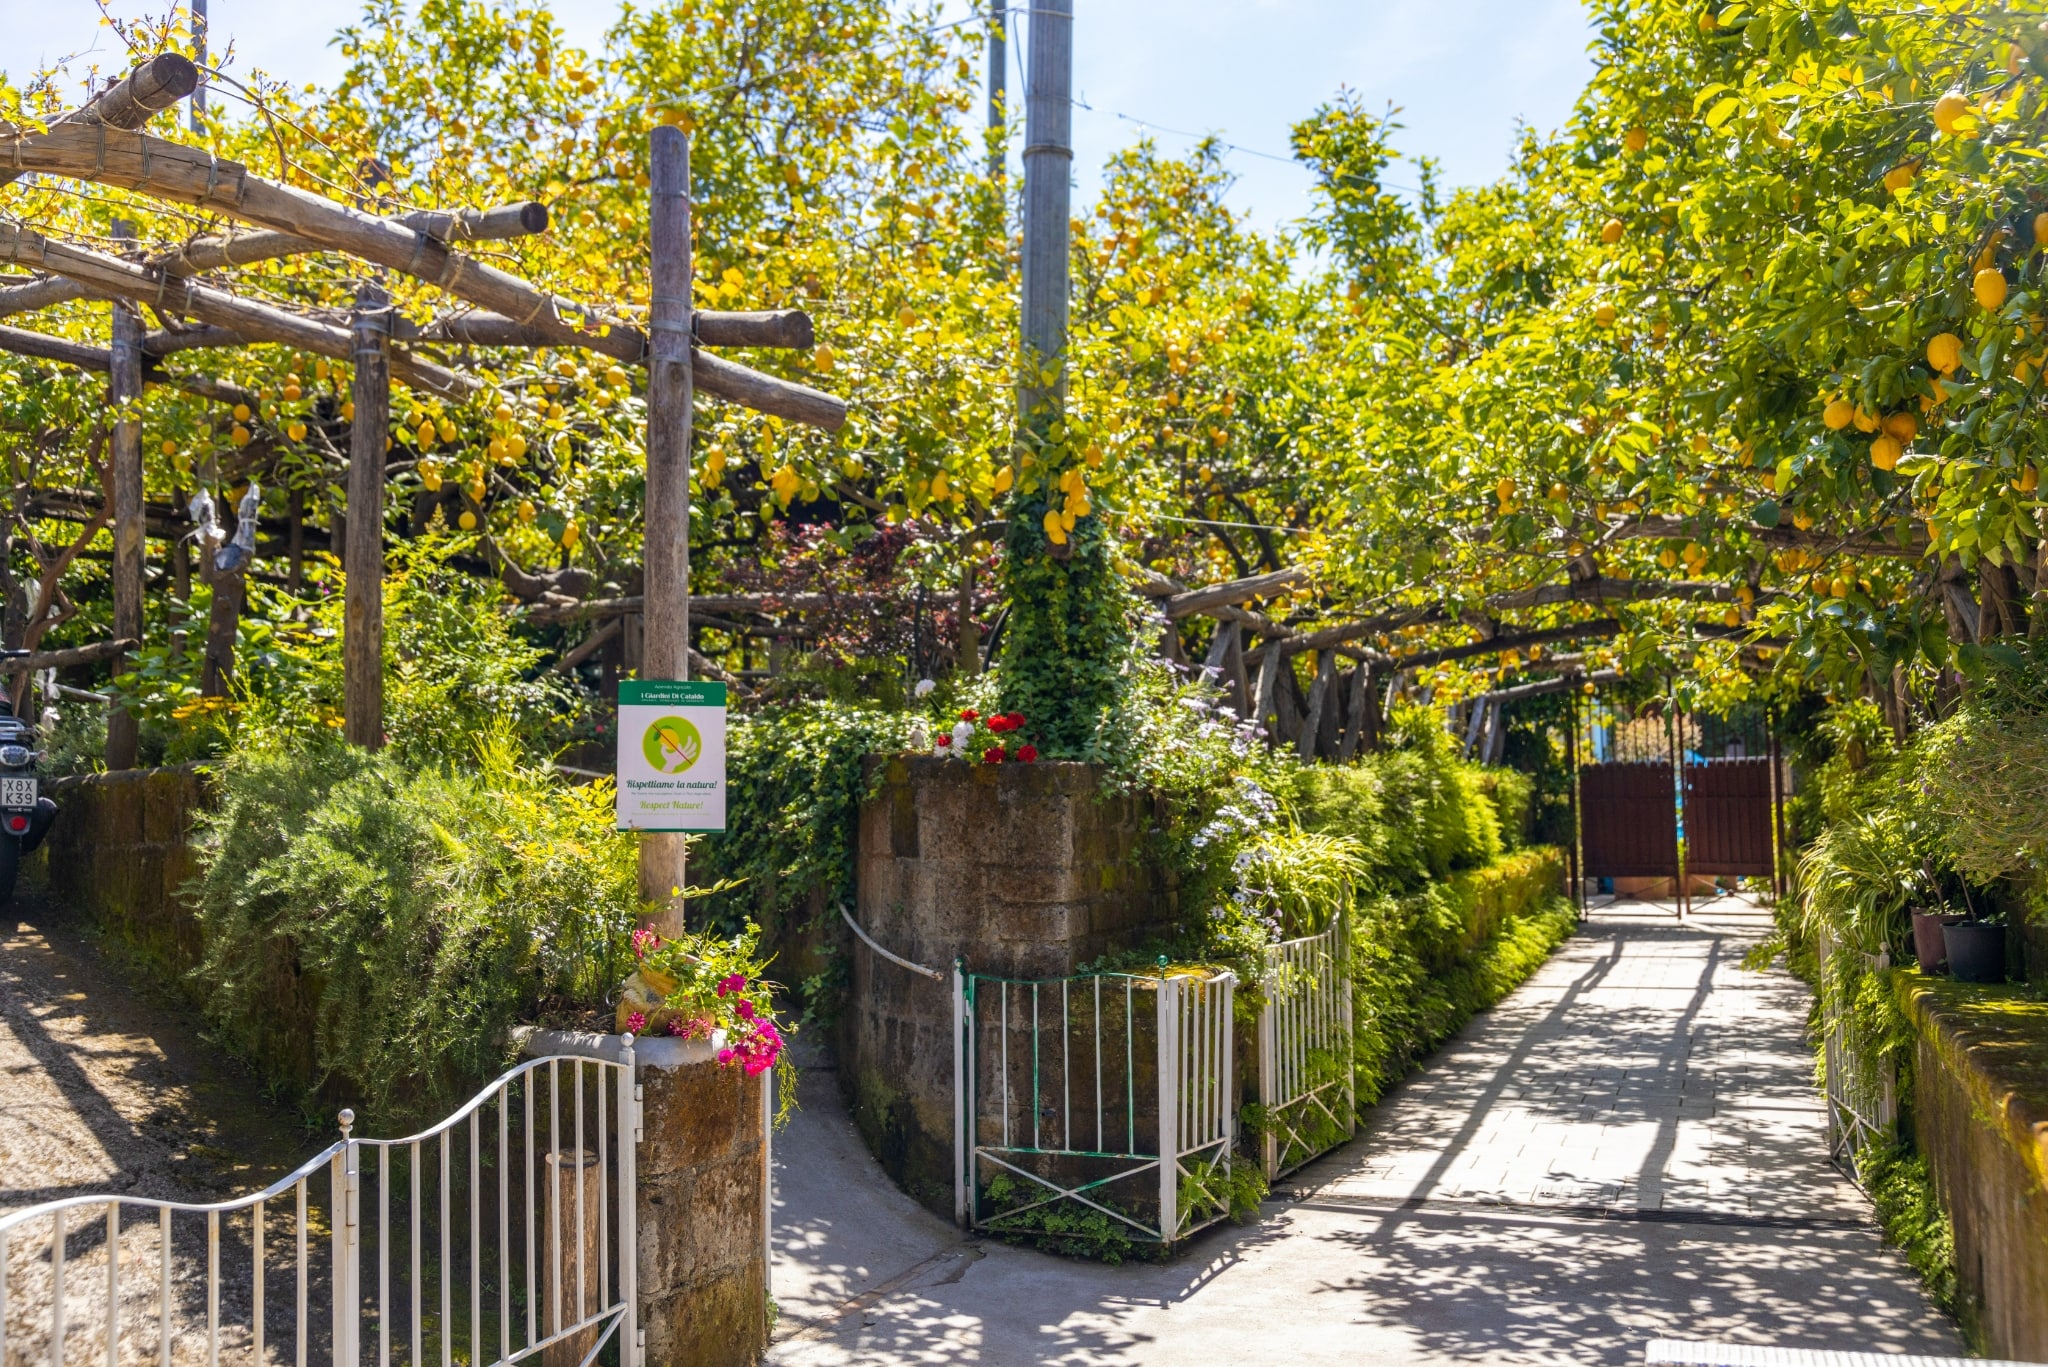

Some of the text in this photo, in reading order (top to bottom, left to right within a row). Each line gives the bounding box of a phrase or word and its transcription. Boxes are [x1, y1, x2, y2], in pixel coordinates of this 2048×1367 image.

[6, 780, 33, 792] X8X
[626, 780, 718, 791] Rispettiamo la natura!
[6, 792, 33, 805] K39
[640, 801, 704, 812] Respect Nature!
